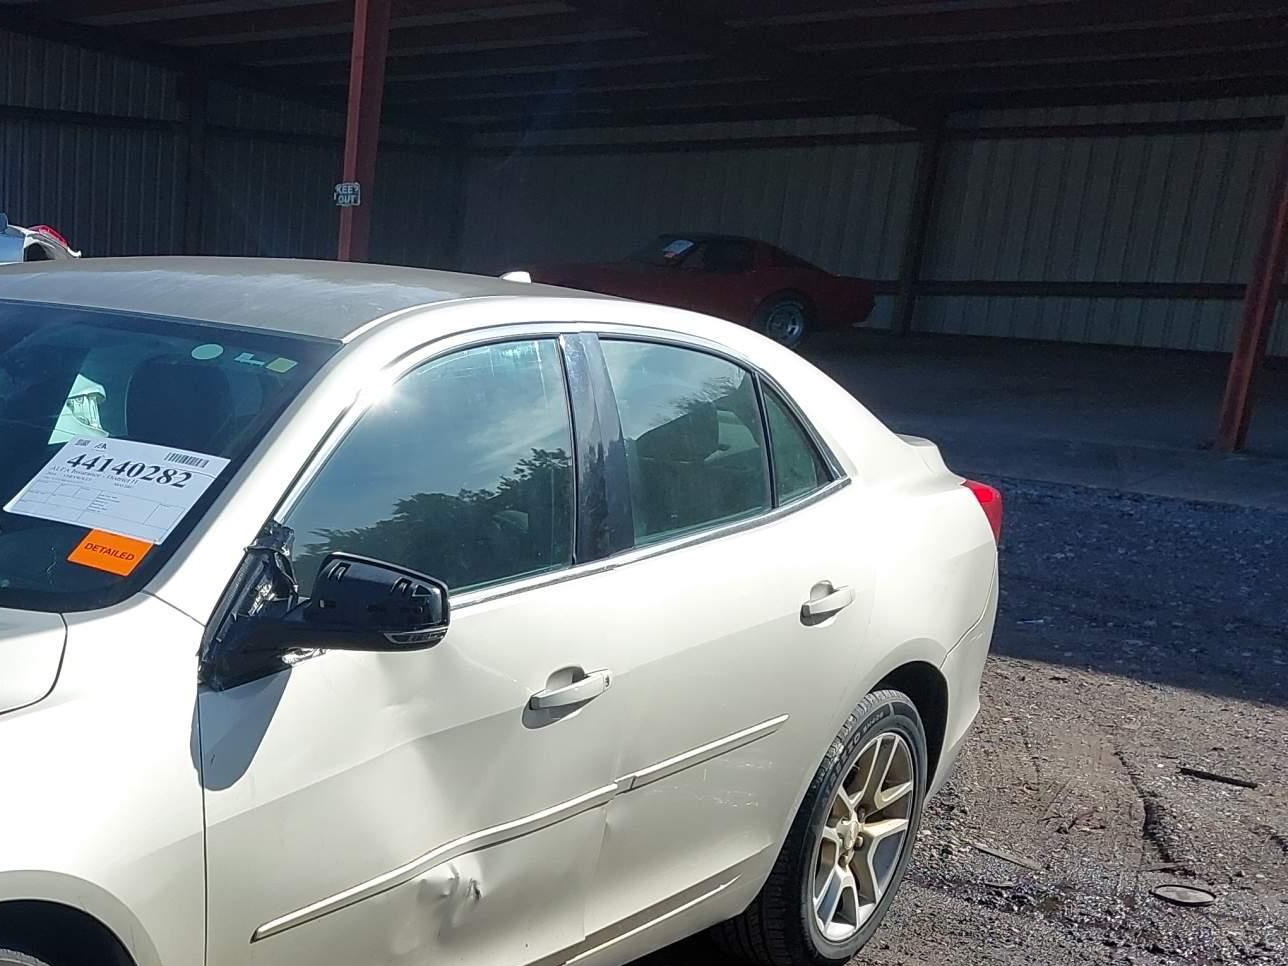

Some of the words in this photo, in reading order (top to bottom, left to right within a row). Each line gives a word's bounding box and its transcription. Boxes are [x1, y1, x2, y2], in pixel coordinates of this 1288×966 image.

[338, 195, 357, 204] OUT
[66, 453, 193, 489] 44140282
[83, 542, 136, 562] DETAILED
